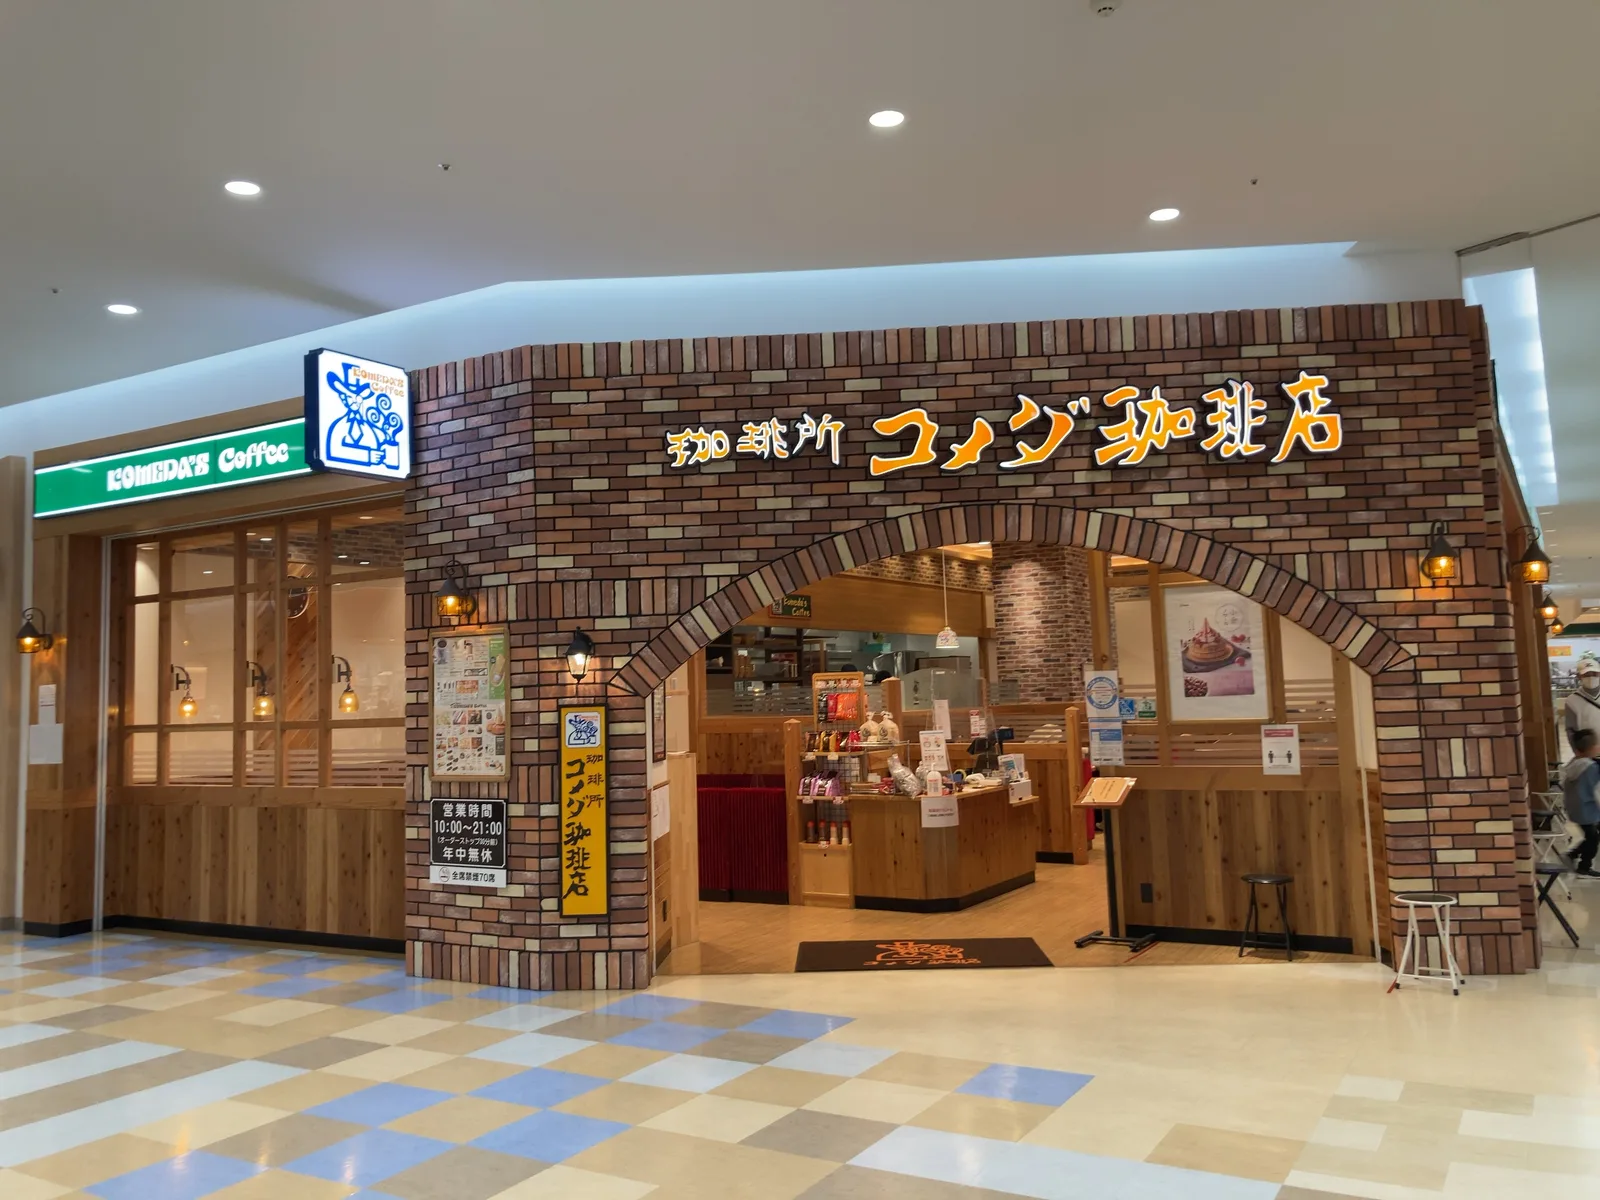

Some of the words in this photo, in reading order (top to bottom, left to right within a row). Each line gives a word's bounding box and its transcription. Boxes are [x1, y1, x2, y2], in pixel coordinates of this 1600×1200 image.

[371, 382, 405, 398] Coffee
[869, 369, 1343, 477] コメダ珈琲店
[106, 450, 210, 492] KOMEDA'S
[218, 439, 289, 474] Coffee
[442, 802, 493, 819] 営業時間
[562, 757, 592, 899] コメダ珈琲店
[442, 846, 493, 863] 年中無休
